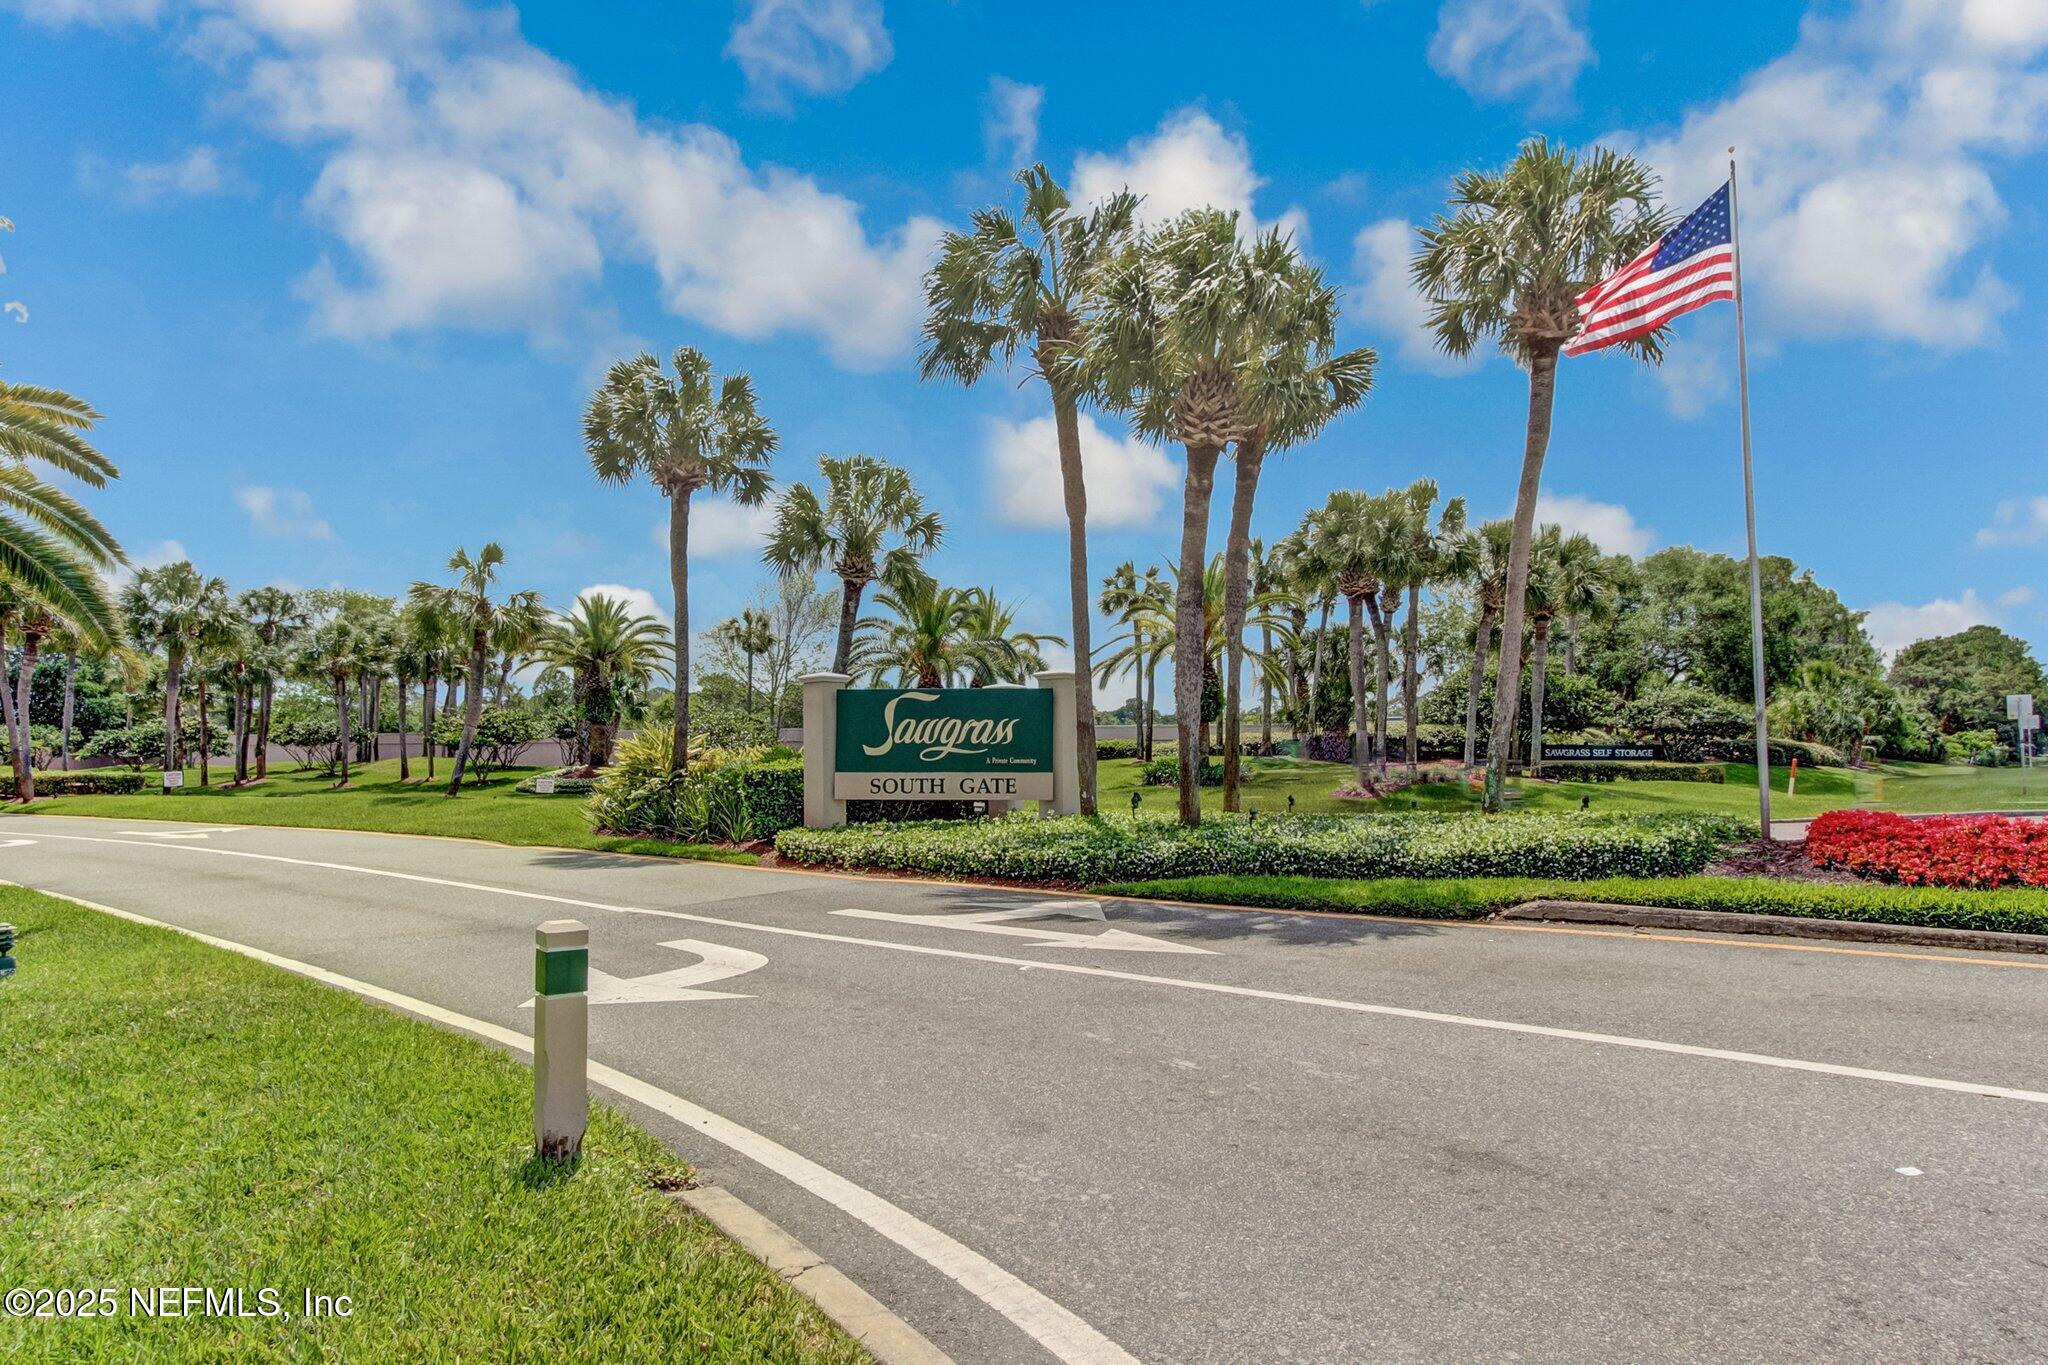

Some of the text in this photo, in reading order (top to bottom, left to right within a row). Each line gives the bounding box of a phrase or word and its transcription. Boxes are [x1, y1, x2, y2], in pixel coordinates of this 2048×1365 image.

[862, 691, 1020, 762] Sawgrass
[1545, 748, 1653, 757] SAWGRASS SELF STORAGE
[870, 777, 1017, 795] SOUTH GATE
